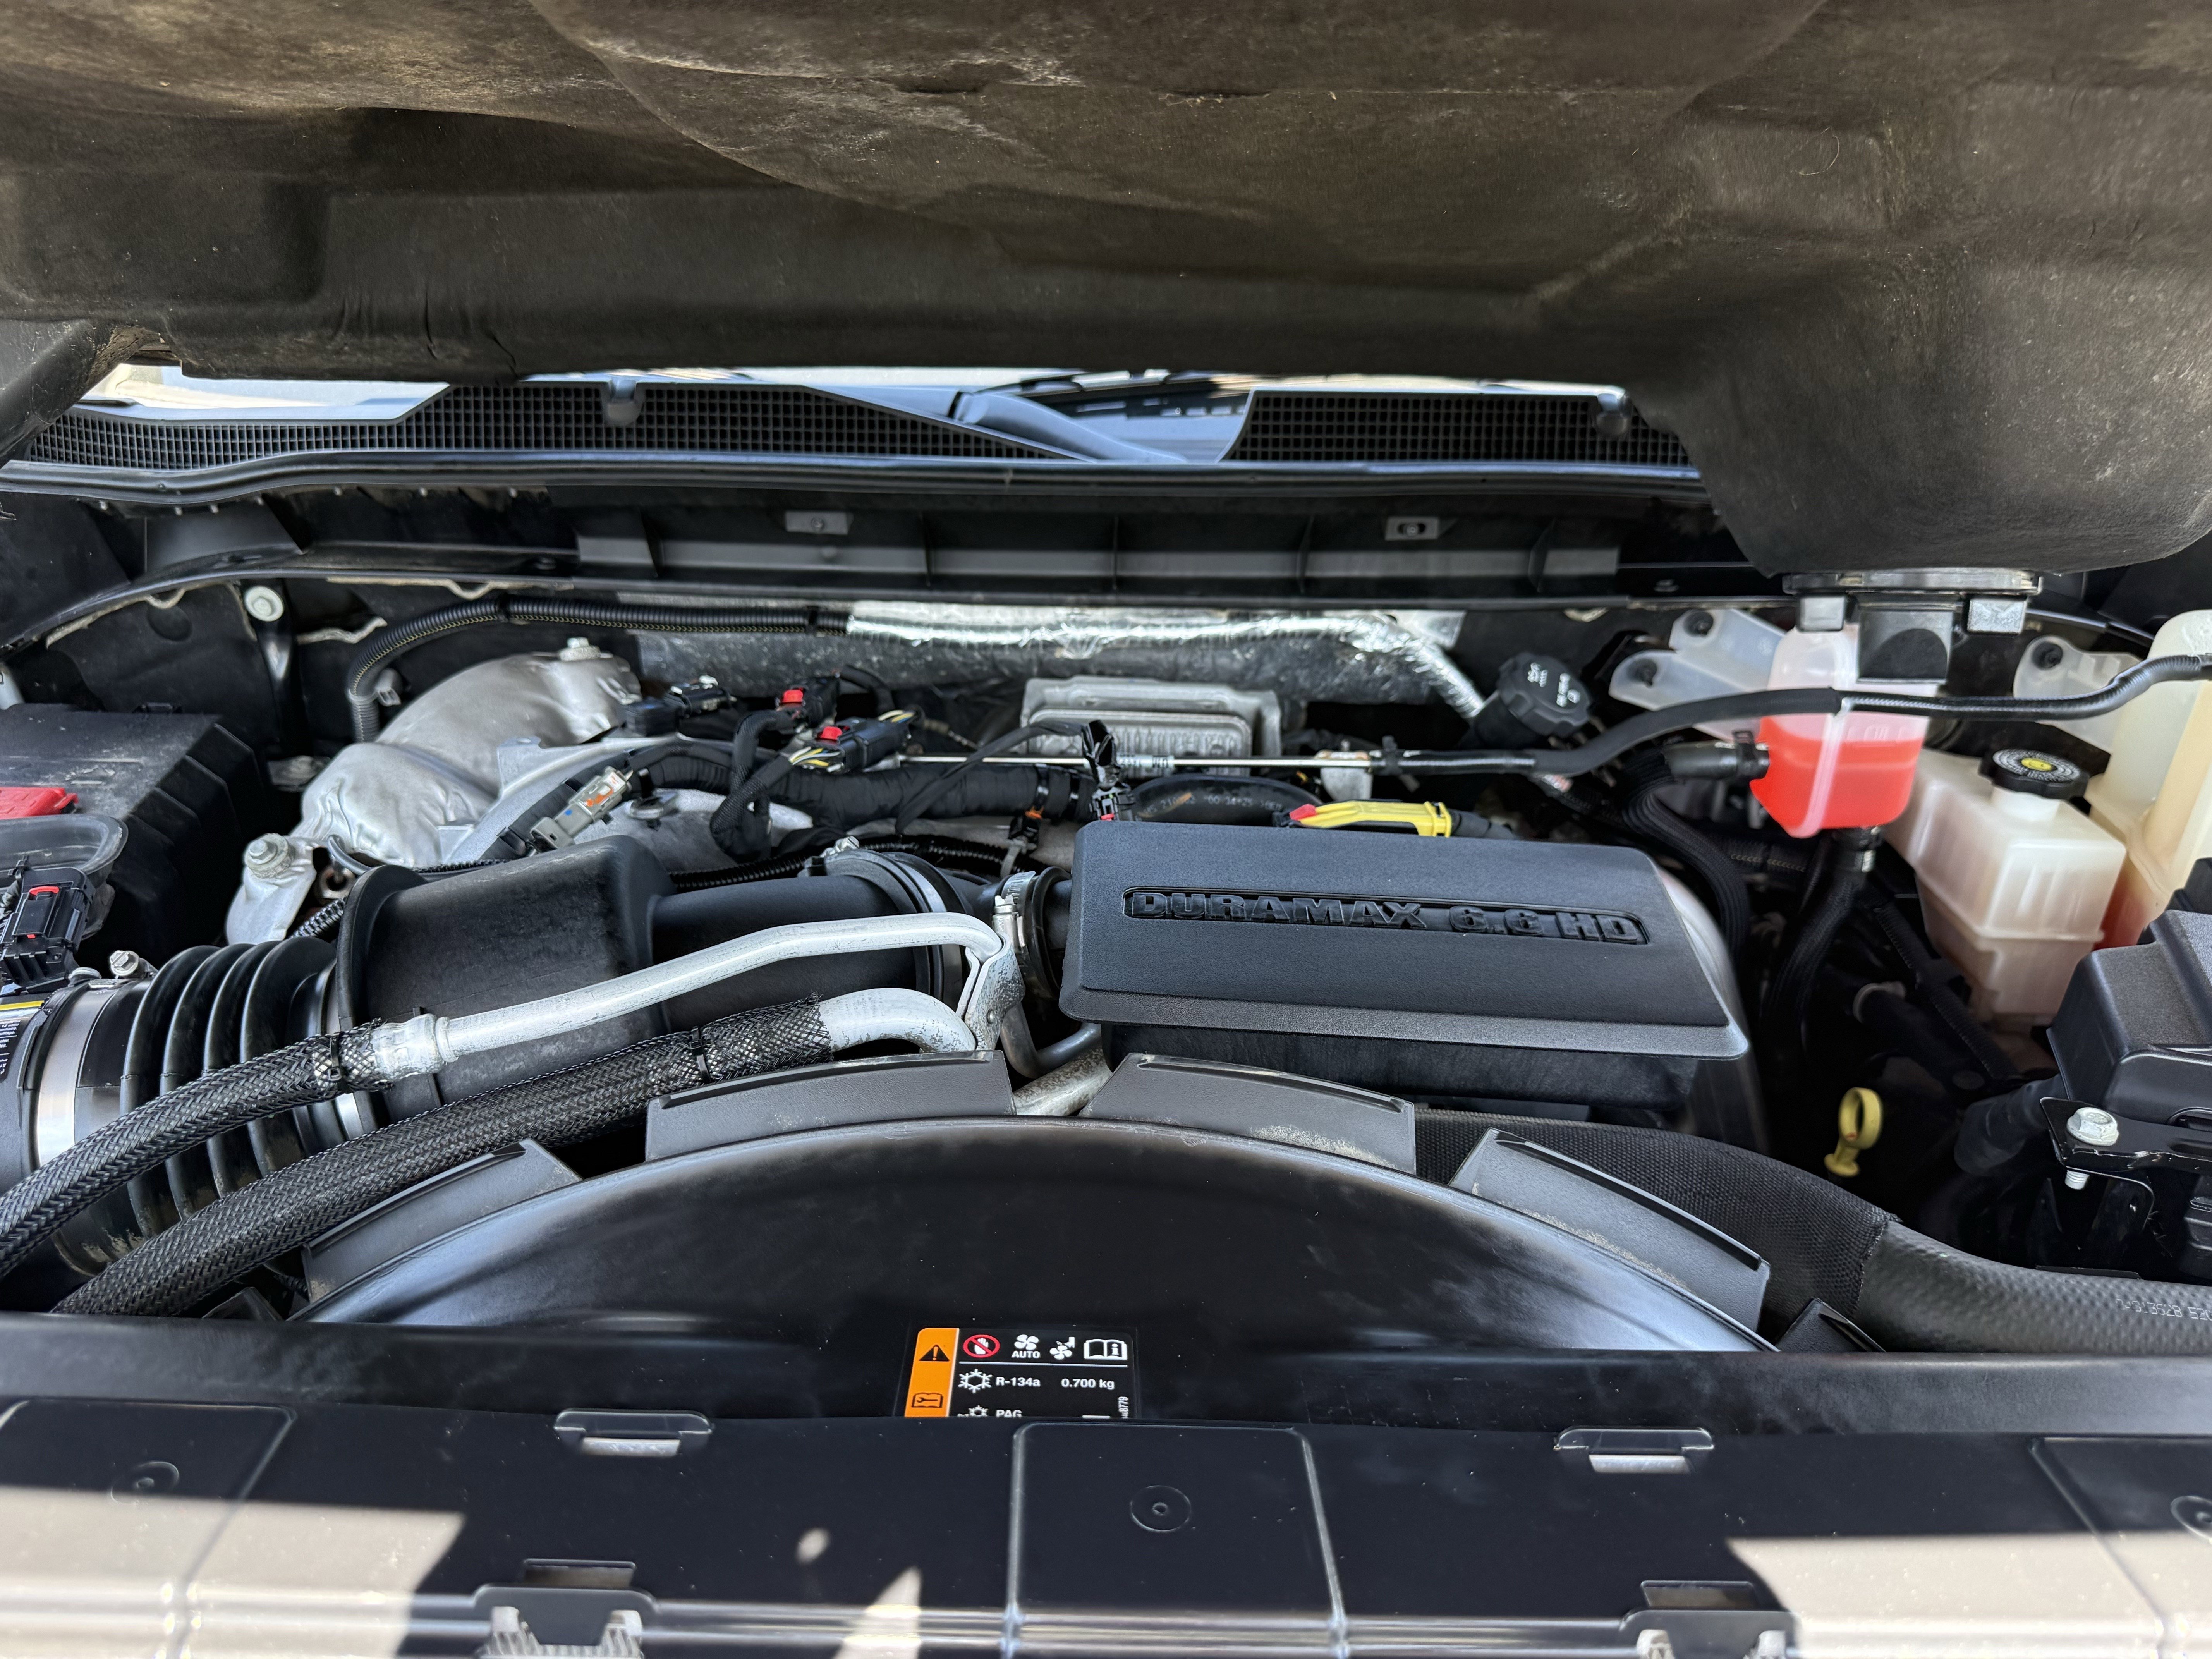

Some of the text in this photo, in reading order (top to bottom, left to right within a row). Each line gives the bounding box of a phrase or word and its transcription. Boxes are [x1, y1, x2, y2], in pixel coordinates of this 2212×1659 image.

[1131, 892, 1638, 941] DURAMAX 6.6 HD
[1011, 1350, 1041, 1359] AUTO
[996, 1377, 1115, 1390] R-134a 0.700 kg
